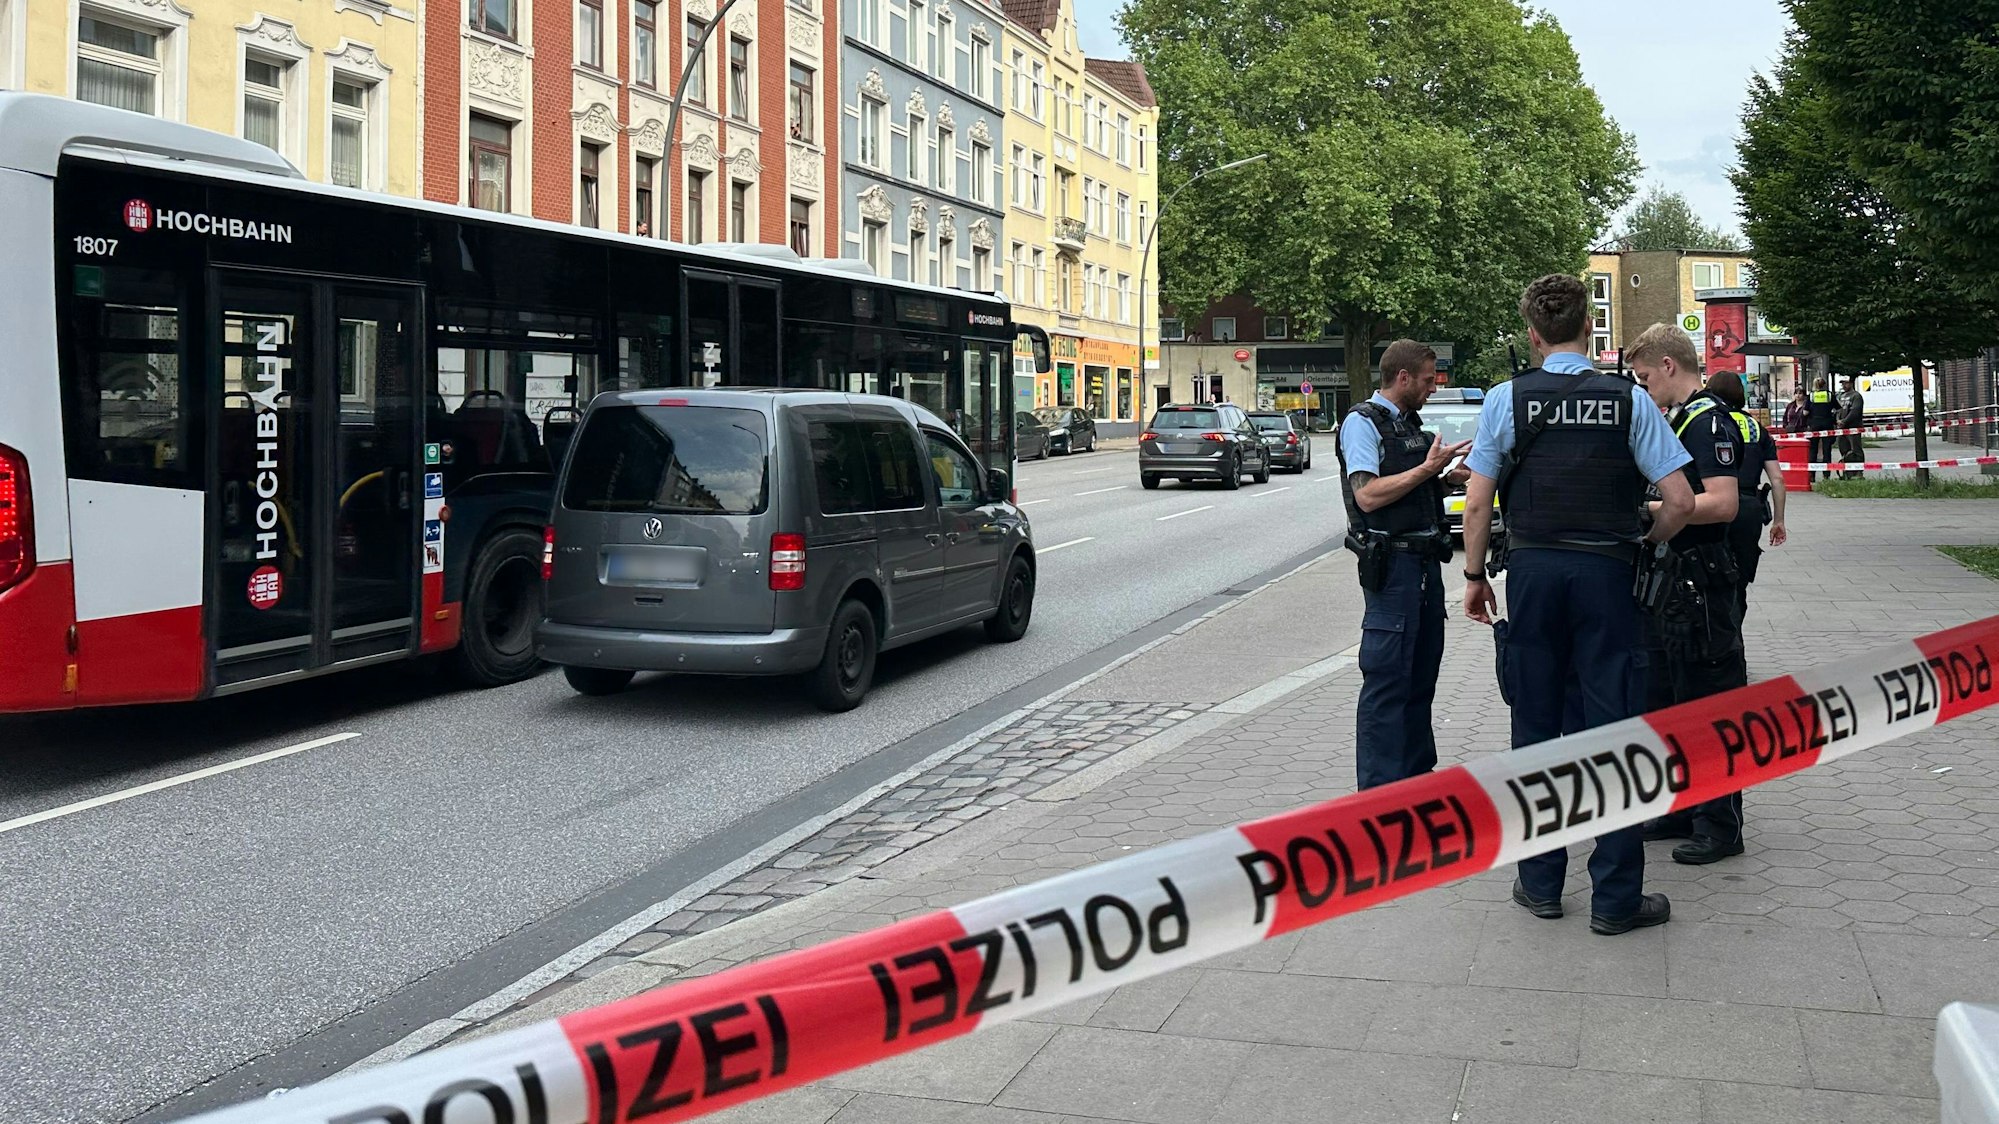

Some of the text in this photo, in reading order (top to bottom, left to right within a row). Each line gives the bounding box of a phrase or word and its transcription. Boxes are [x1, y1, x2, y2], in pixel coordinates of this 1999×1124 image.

[73, 235, 119, 256] 1807
[156, 208, 292, 243] HOCHBAHN
[974, 314, 1004, 327] HOCHBAHN
[1527, 399, 1620, 426] POLIZEI
[1872, 378, 1914, 387] ALLROUND
[256, 321, 279, 560] HOCHBAHN
[1873, 644, 1992, 725] POLIZEI
[1711, 686, 1857, 776] POLIZEI
[1506, 734, 1690, 839] POLIZEI
[1236, 795, 1475, 924] POLIZEI
[868, 877, 1189, 1042] POLIZEI
[328, 994, 788, 1124] OLIZEI
